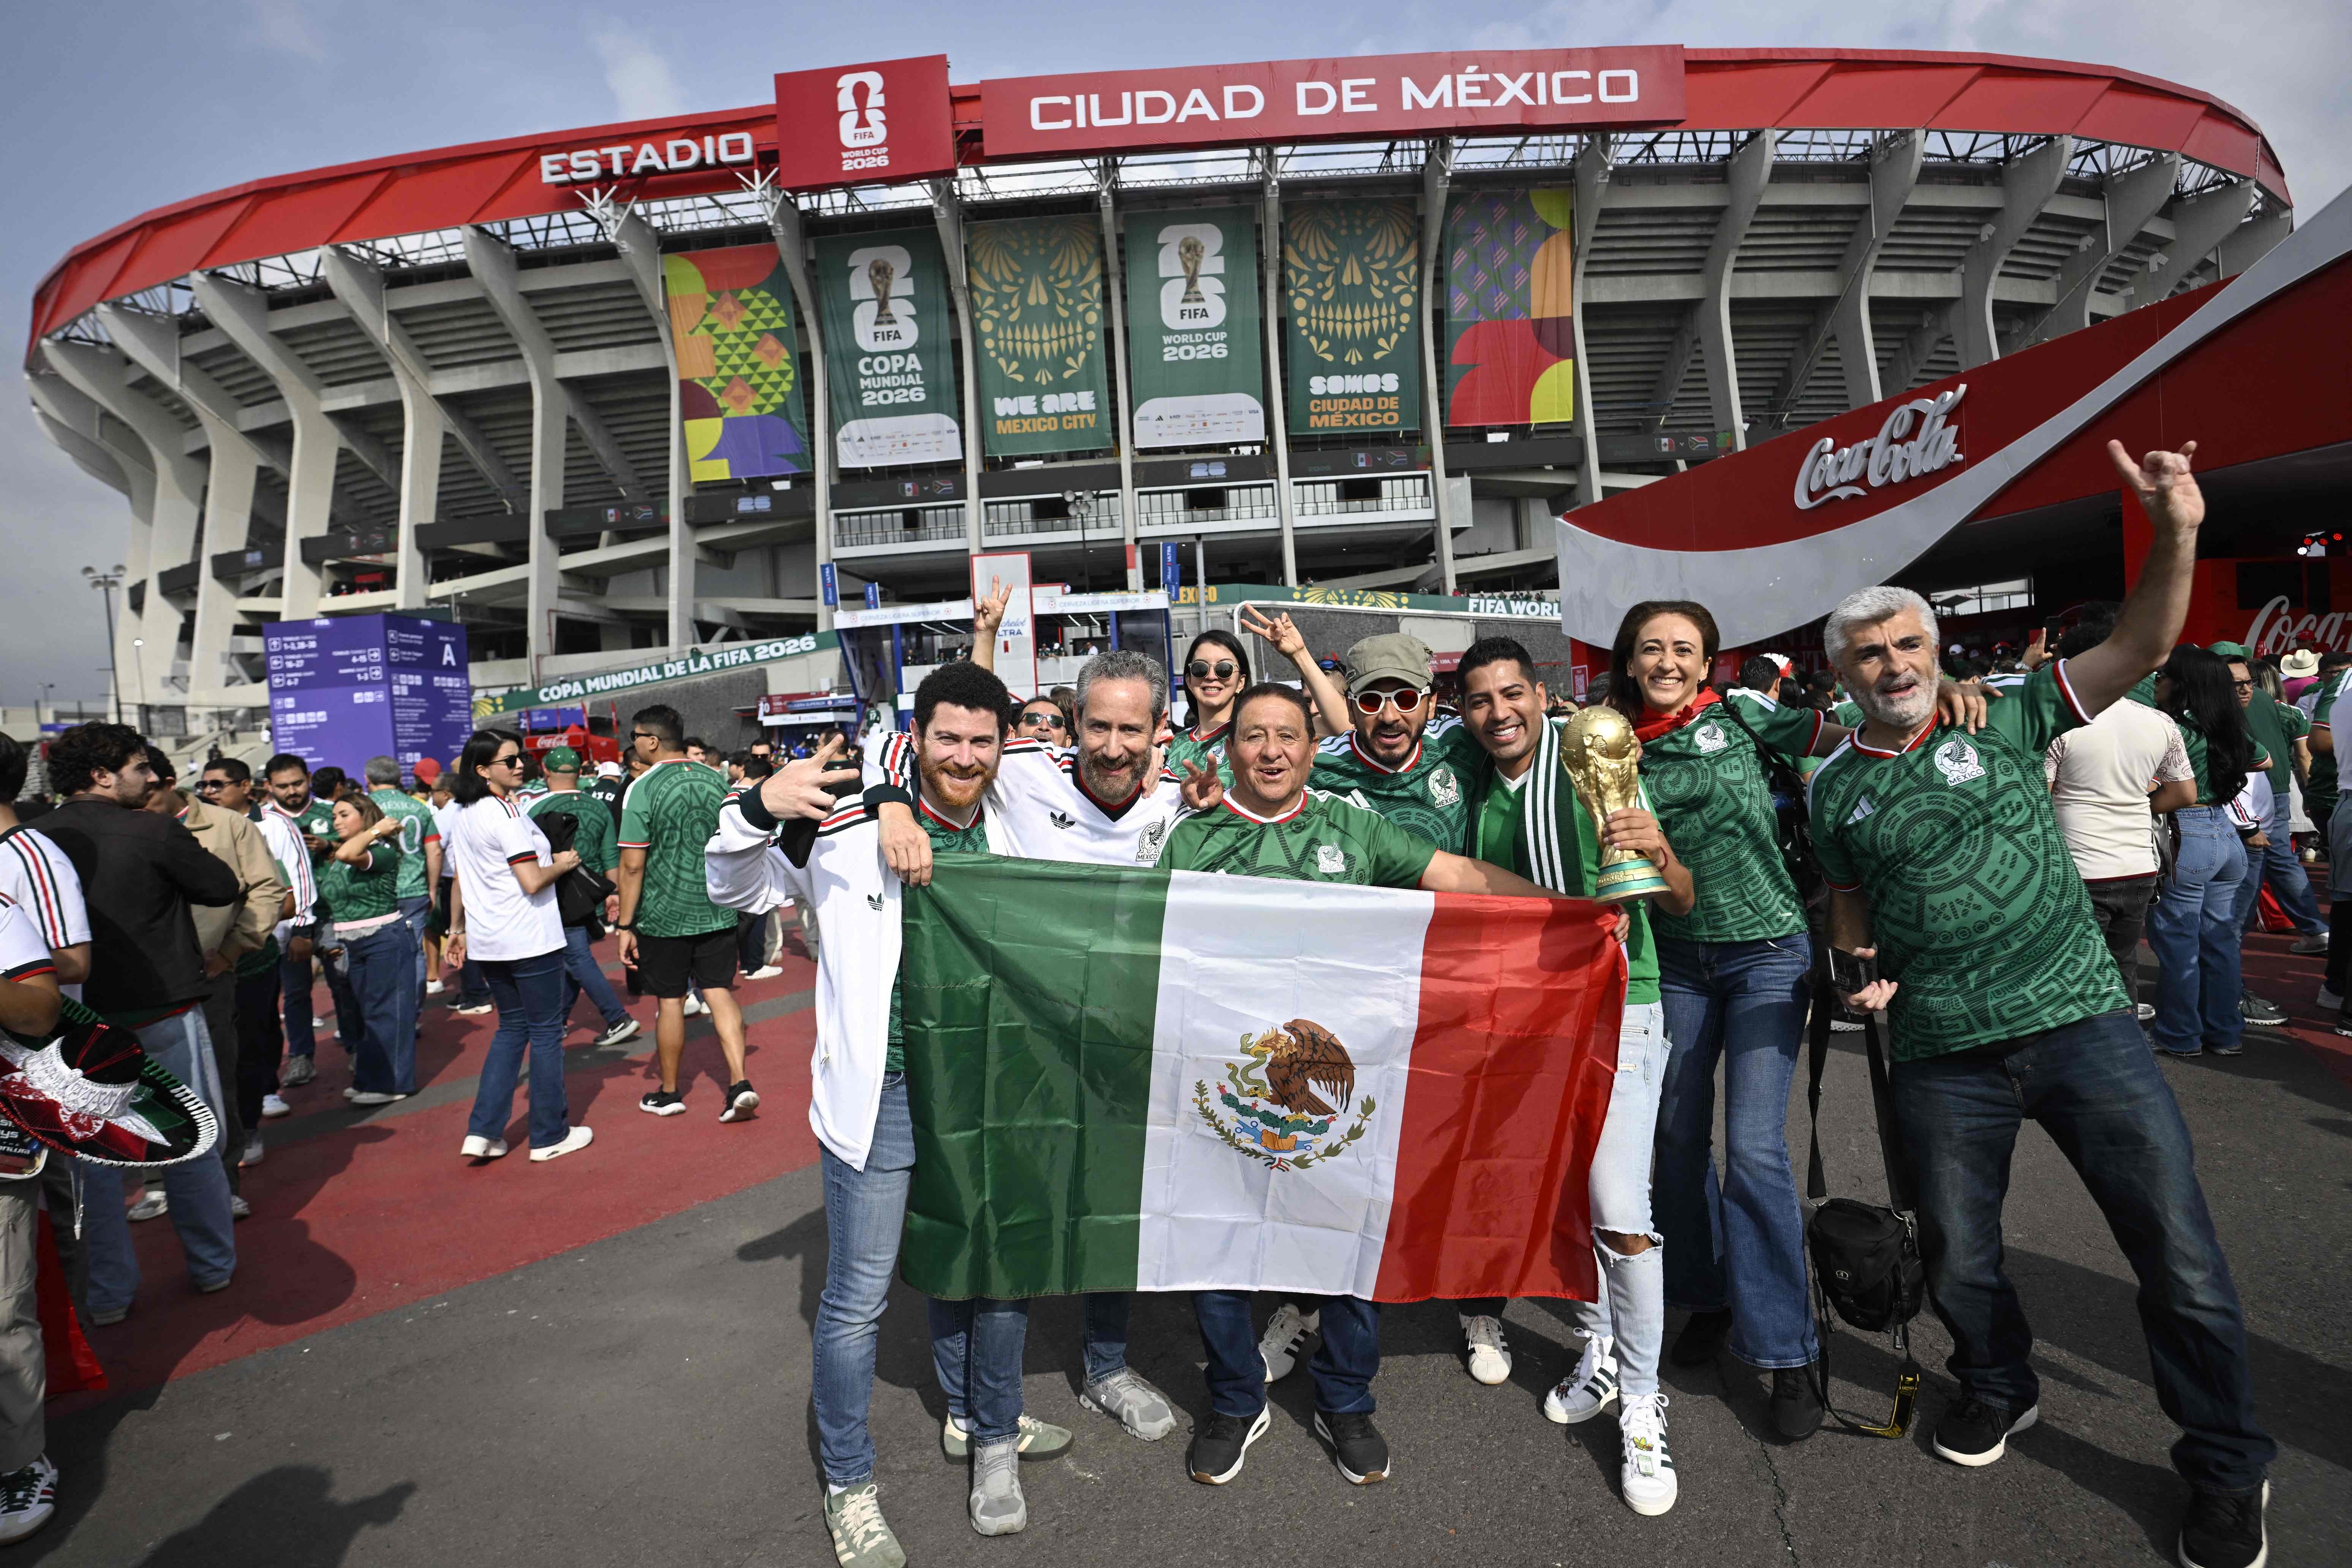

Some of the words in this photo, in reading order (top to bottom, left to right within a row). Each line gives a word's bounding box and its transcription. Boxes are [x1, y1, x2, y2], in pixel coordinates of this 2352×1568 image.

[1031, 85, 1265, 130] CIUDAD
[1296, 78, 1377, 115] DE
[1402, 65, 1638, 110] MÉXICO
[854, 131, 874, 140] FIFA
[541, 132, 754, 184] ESTADIO
[841, 149, 871, 158] WORLD
[842, 155, 889, 171] 2026
[1180, 308, 1209, 319] FIFA
[874, 330, 902, 342] FIFA
[1163, 333, 1203, 344] WORLD
[1205, 332, 1227, 341] CUP
[1163, 343, 1228, 361] 2026
[858, 354, 923, 376] COPA
[860, 374, 924, 390] MUNDIAL
[1309, 373, 1399, 395] SOMOS
[861, 388, 926, 406] 2026
[994, 395, 1037, 416] WE
[1042, 390, 1095, 413] ARE
[1310, 398, 1371, 413] CIUDAD
[1378, 397, 1399, 410] DE
[997, 417, 1058, 434] MEXICO
[1062, 415, 1095, 430] CITY
[1310, 411, 1399, 427] MÉXICO
[1794, 384, 1967, 509] Coca-Cola
[1468, 598, 1508, 614] FIFA
[861, 613, 889, 621] CERVEZA
[889, 610, 910, 620] LIGERA
[910, 610, 940, 618] SUPERIOR
[1001, 617, 1027, 627] chelob
[443, 644, 456, 666] A
[539, 682, 583, 703] COPA
[586, 667, 662, 692] MUNDIAL
[664, 659, 686, 677] DE
[689, 656, 711, 673] LA
[713, 649, 752, 668] FIFA
[755, 635, 816, 659] 2026
[1948, 769, 1983, 785] MÉXICO
[1436, 795, 1458, 808] MÉXICO
